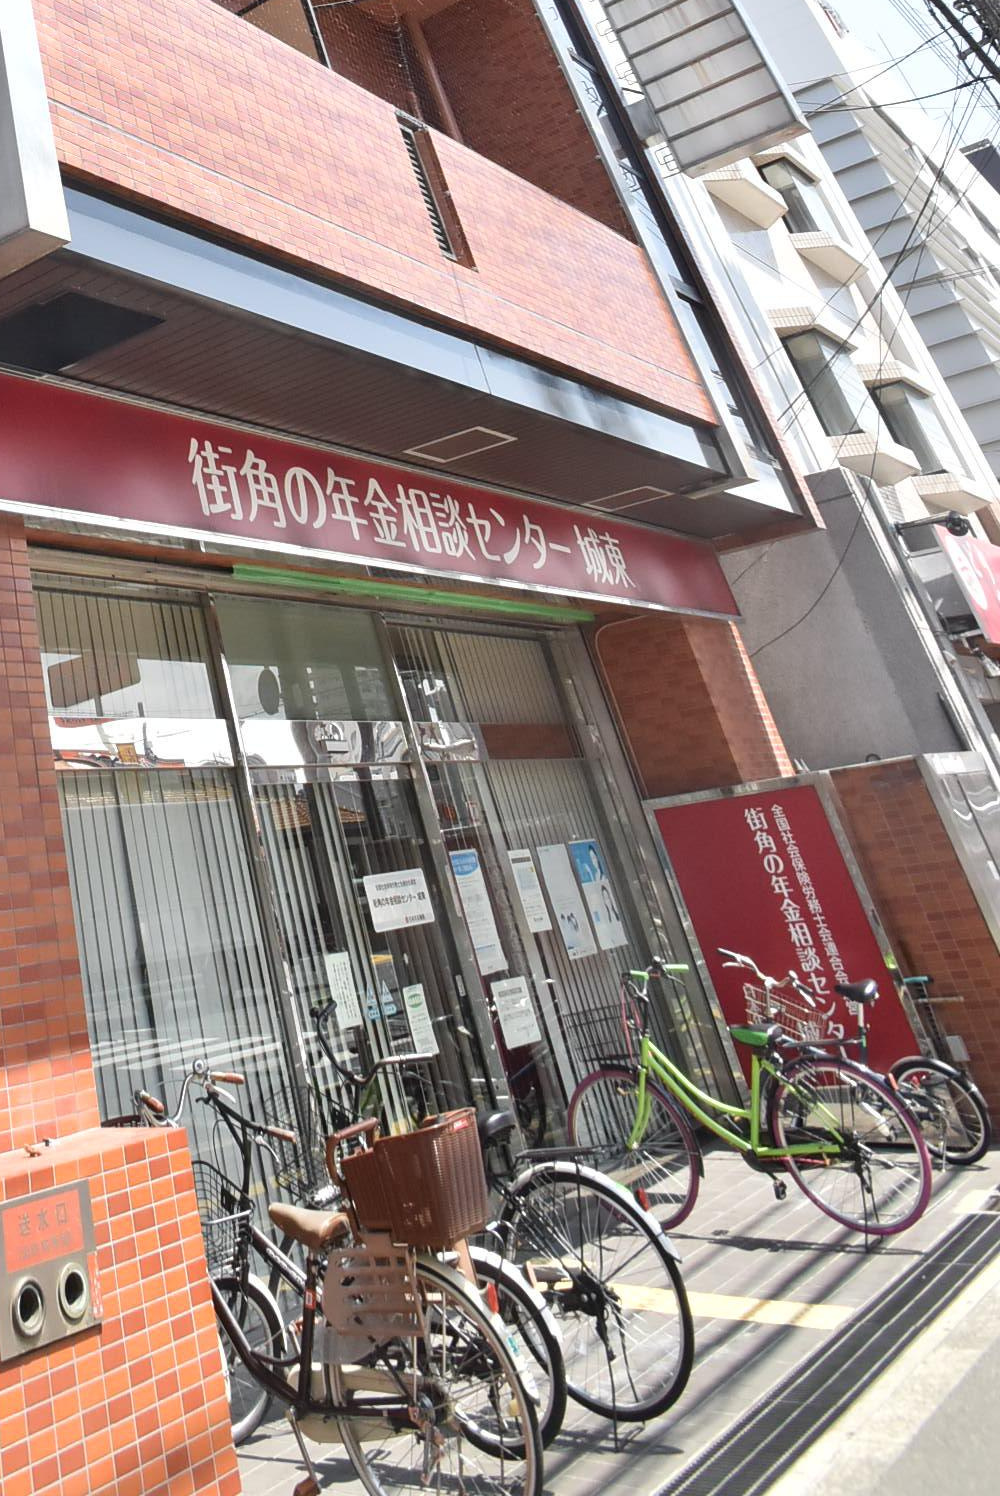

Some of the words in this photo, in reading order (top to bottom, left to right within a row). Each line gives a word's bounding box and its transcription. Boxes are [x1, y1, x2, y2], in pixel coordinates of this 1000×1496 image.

[187, 437, 572, 571] 街角の年金相談センター
[574, 524, 638, 589] 城東
